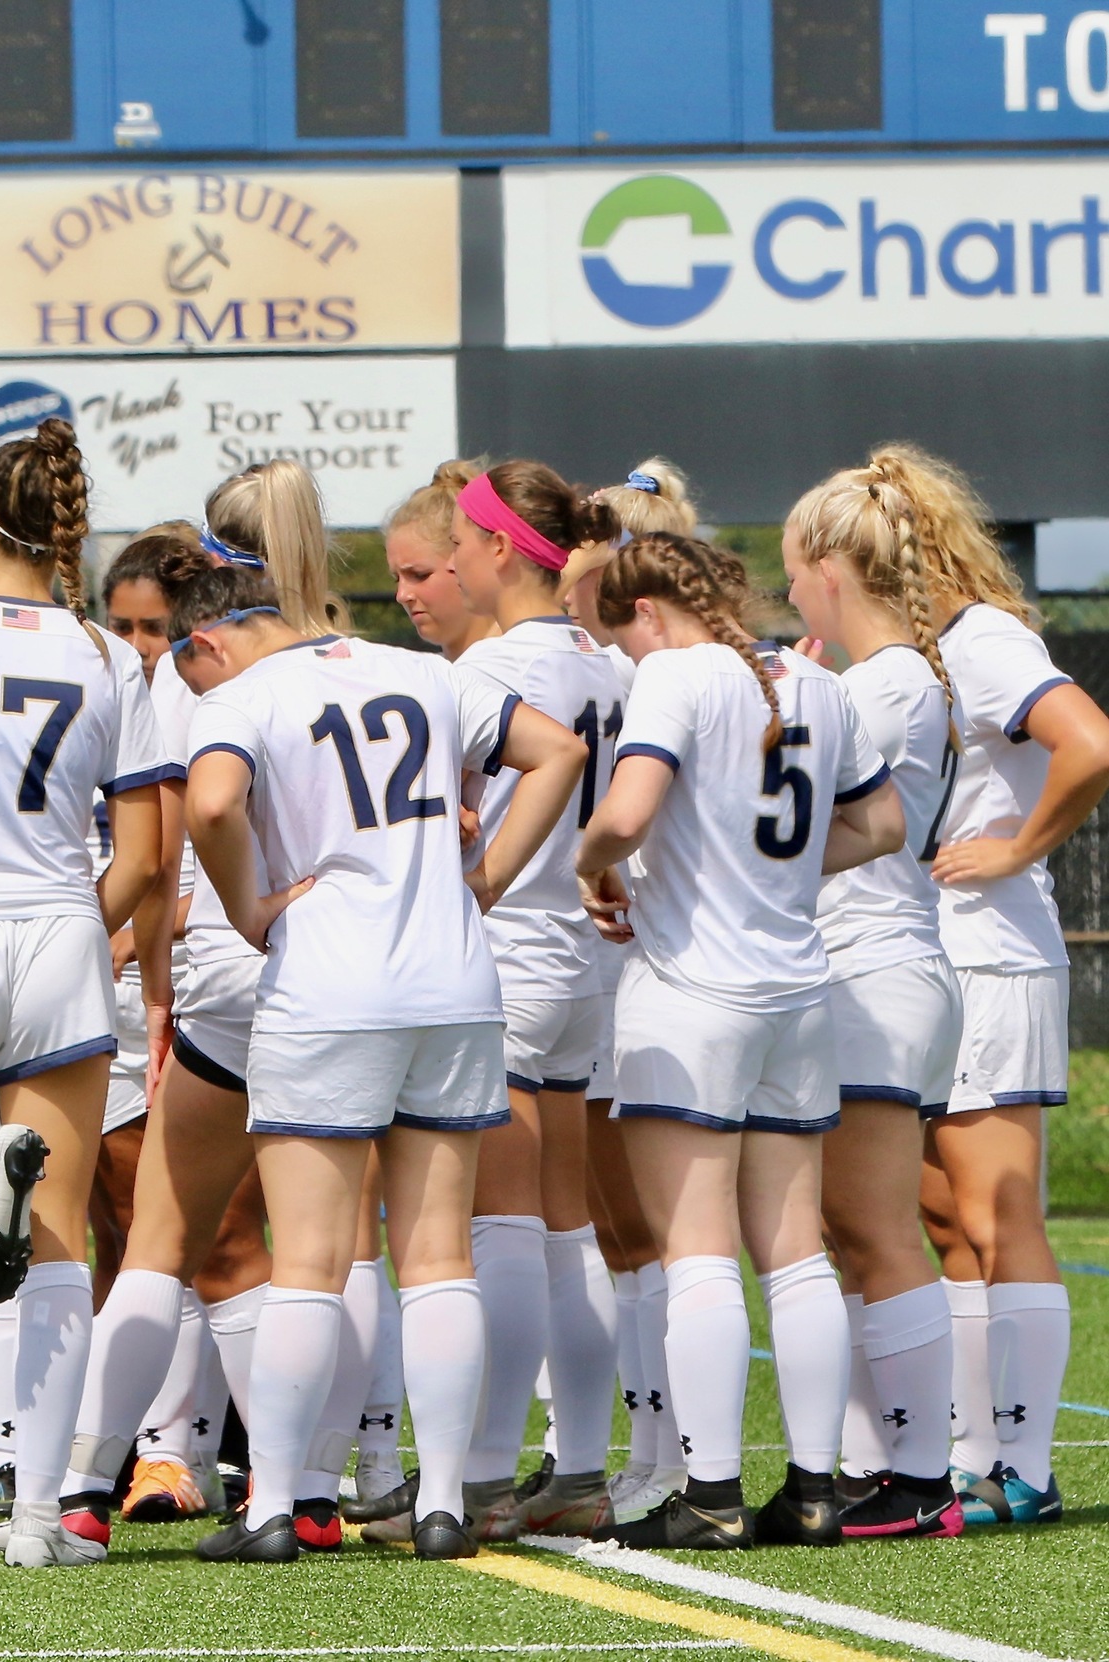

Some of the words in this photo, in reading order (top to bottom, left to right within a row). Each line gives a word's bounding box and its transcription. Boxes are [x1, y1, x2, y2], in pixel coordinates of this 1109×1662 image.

[19, 173, 175, 276] LONG
[193, 170, 360, 267] BUILT
[36, 297, 358, 345] HOMES
[81, 378, 183, 431] Thank
[205, 401, 282, 434] For
[302, 400, 413, 432] Your
[108, 431, 179, 478] You
[308, 692, 447, 832] 12
[754, 724, 813, 861] 5
